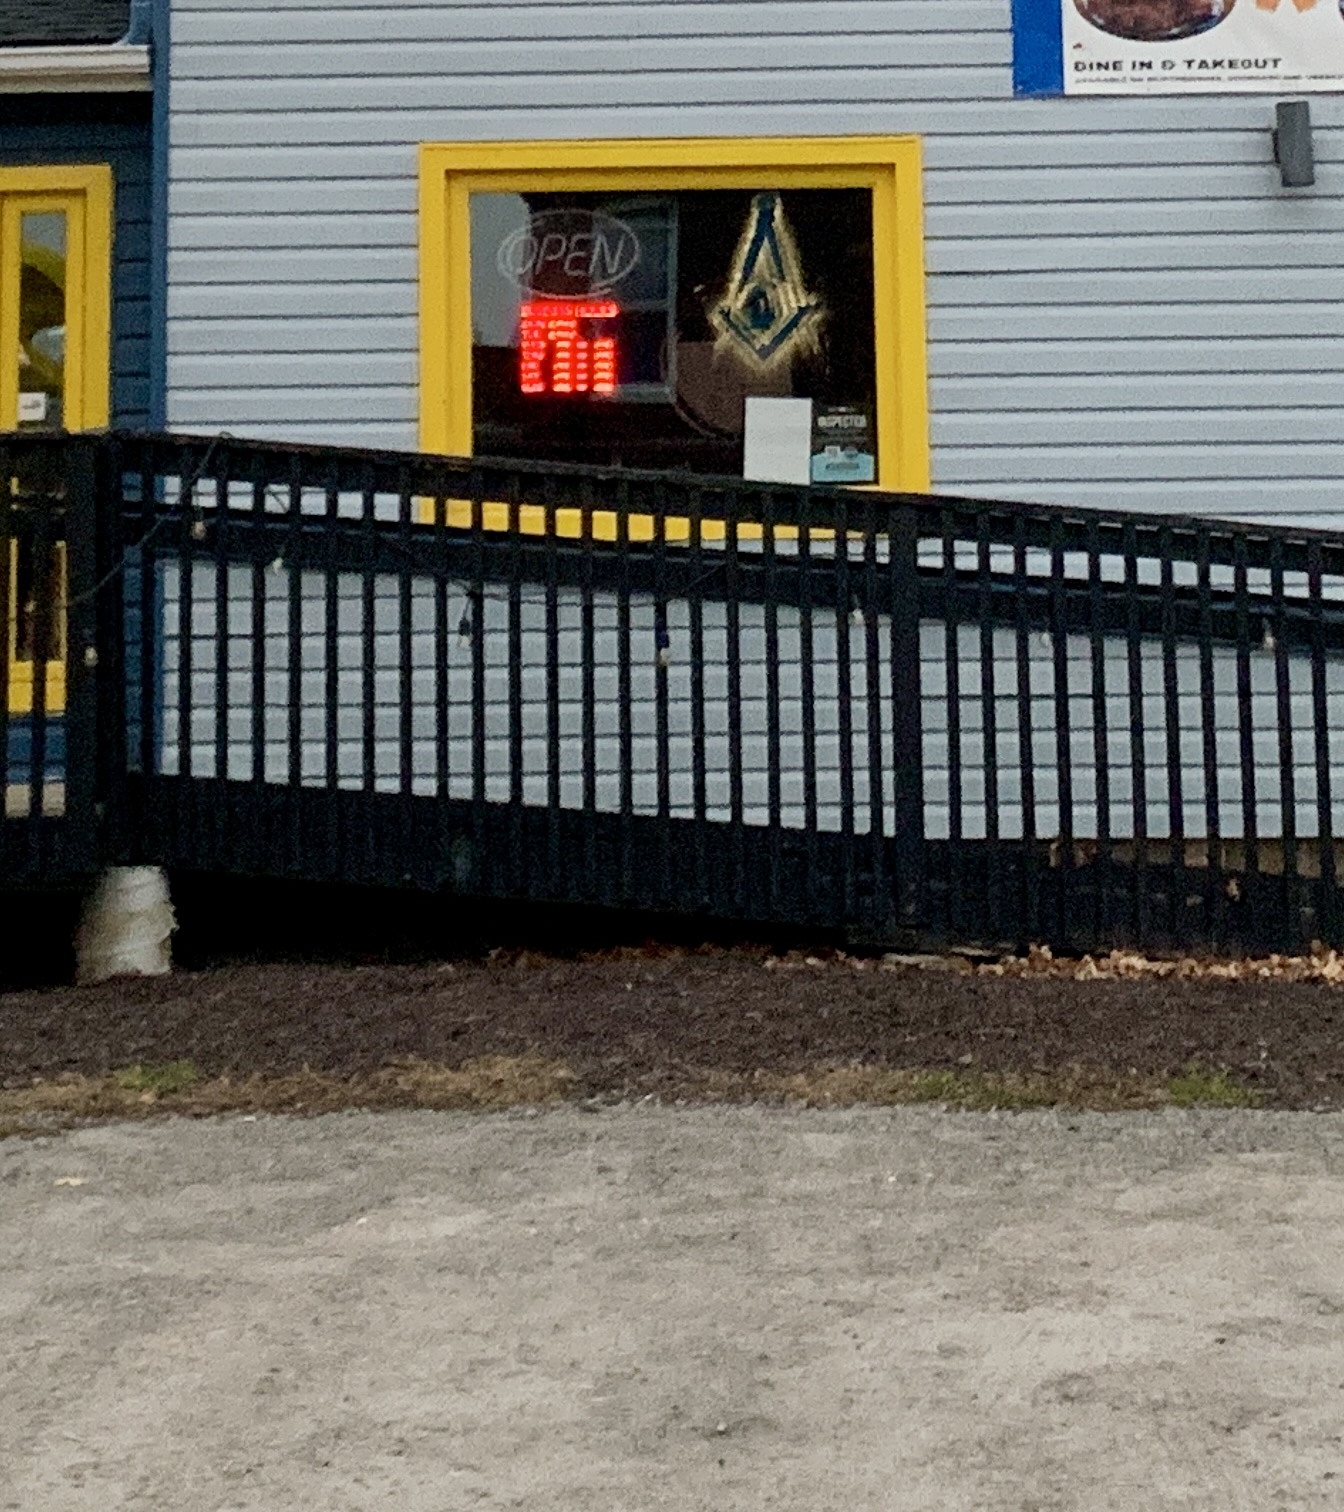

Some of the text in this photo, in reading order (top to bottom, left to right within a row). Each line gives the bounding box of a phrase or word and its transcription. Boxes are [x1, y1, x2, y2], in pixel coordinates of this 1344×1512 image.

[1073, 60, 1124, 72] DINE
[1131, 60, 1153, 71] IN
[1182, 57, 1283, 71] TAKEOUT
[507, 233, 626, 276] OPEN
